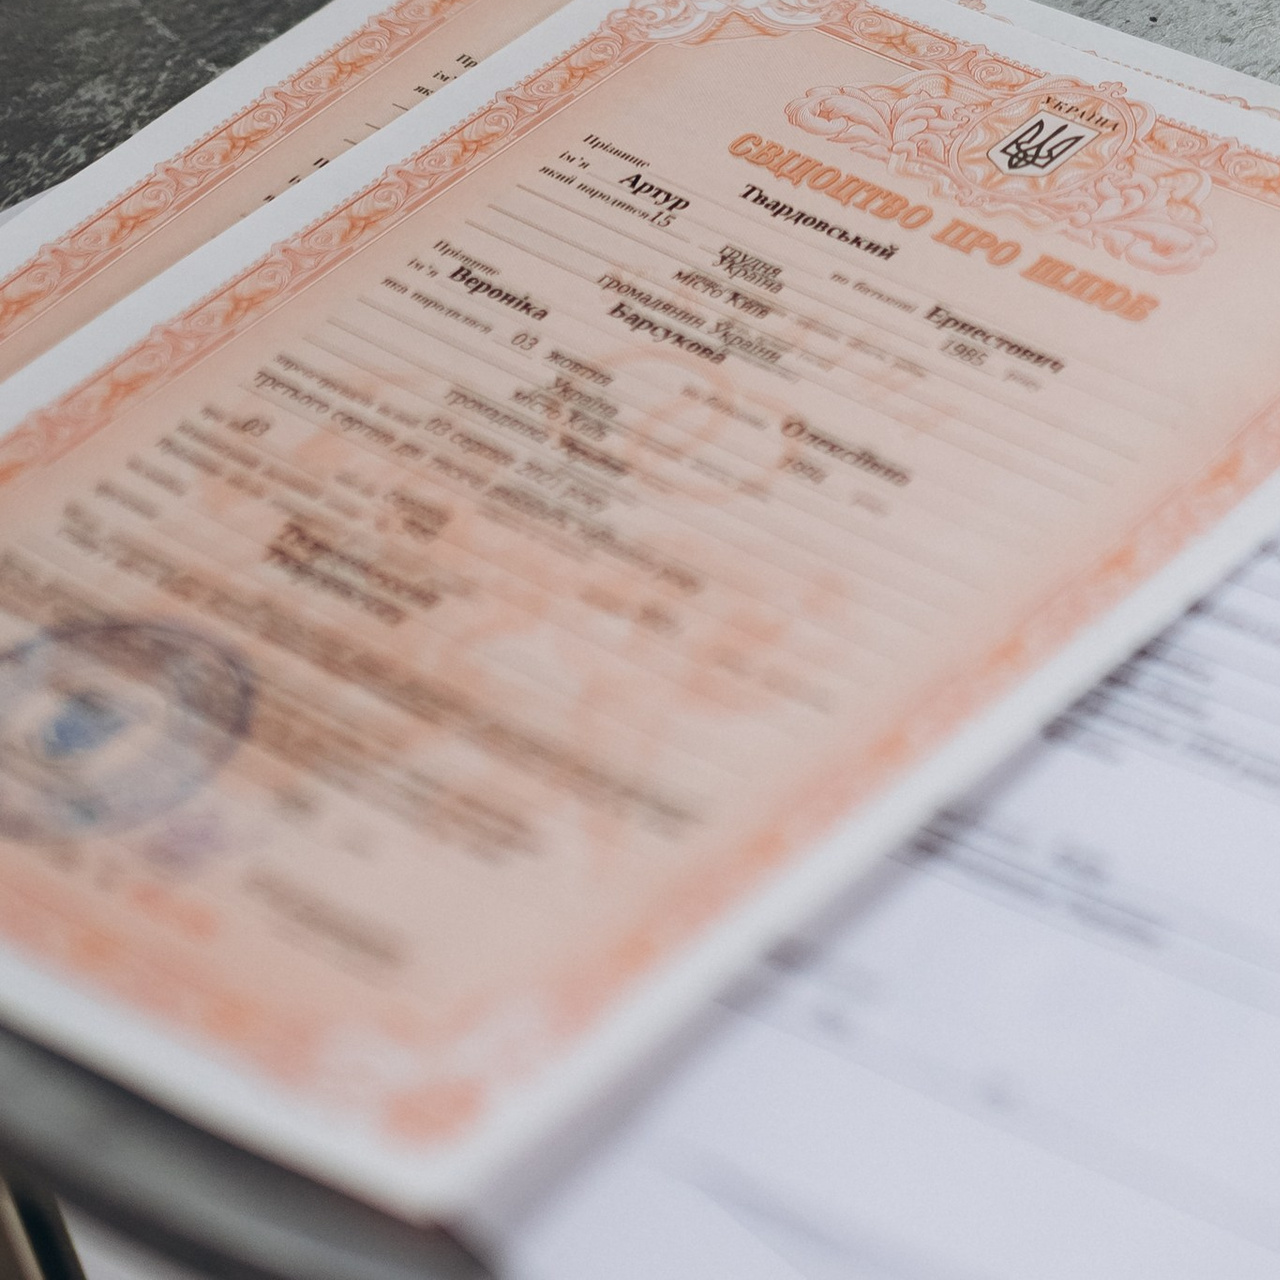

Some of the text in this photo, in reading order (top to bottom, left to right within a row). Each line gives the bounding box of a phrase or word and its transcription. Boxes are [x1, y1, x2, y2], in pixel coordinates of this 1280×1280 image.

[1041, 95, 1119, 132] УКРАЇНА
[582, 133, 900, 262] Прізвище Твардовський
[728, 132, 1161, 322] СВІДОЦТВО ПРО ШЛЮБ
[448, 265, 549, 322] Вероніка
[597, 274, 707, 329] громадянин
[618, 173, 691, 212] Артур
[924, 304, 1066, 374] Ернестович
[648, 210, 677, 229] 15
[938, 339, 990, 367] 1985
[510, 332, 540, 352] 03
[545, 350, 614, 387] жовтня
[607, 301, 727, 365] Барсукова
